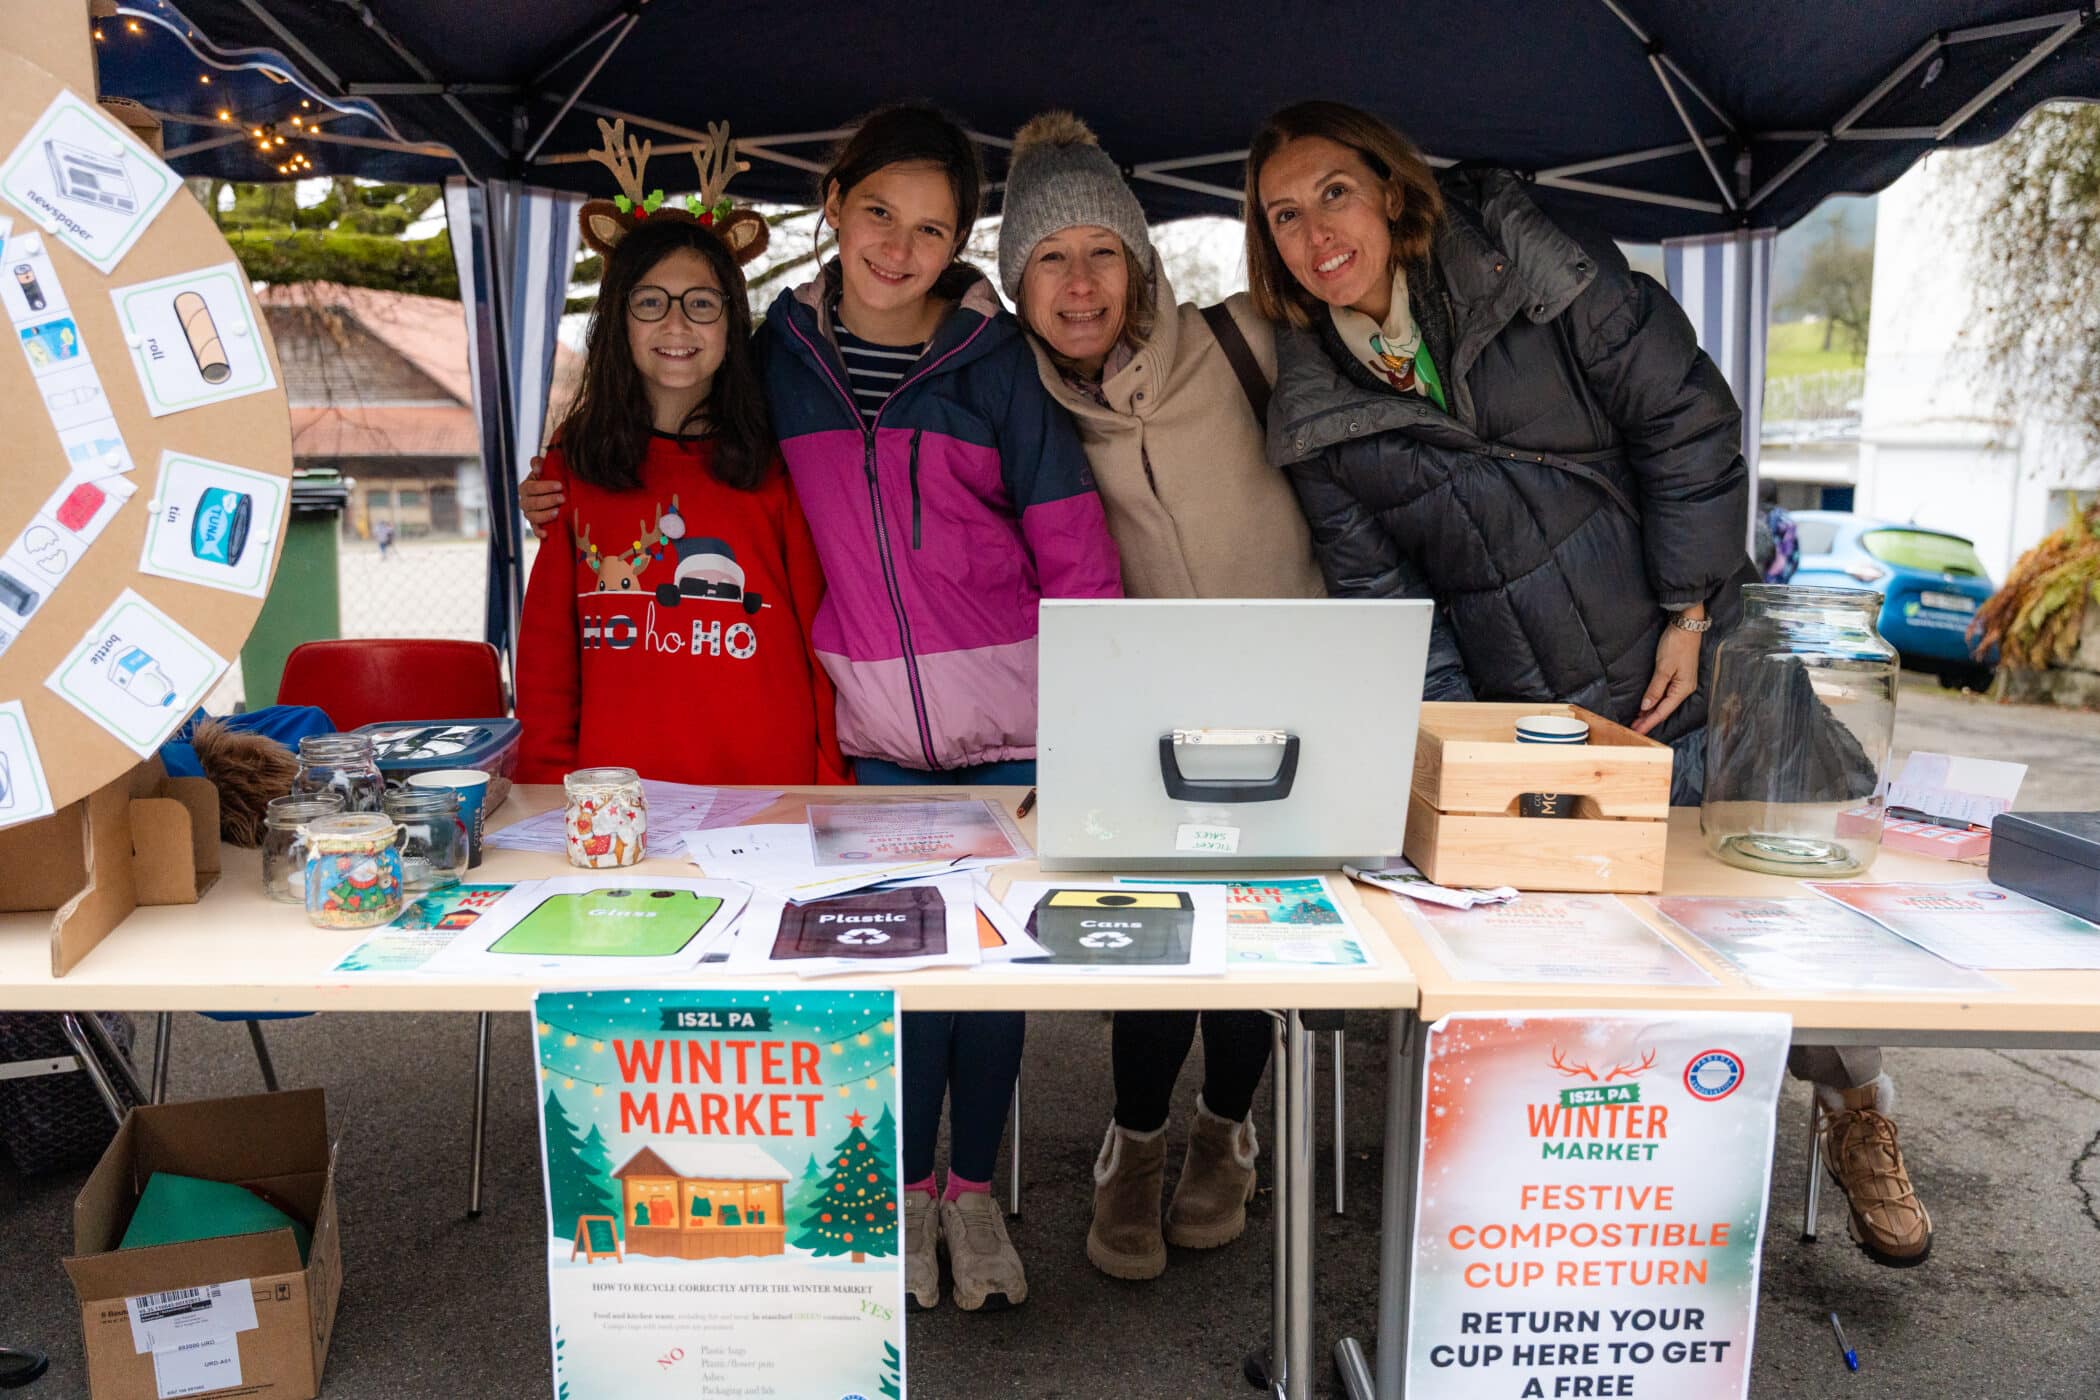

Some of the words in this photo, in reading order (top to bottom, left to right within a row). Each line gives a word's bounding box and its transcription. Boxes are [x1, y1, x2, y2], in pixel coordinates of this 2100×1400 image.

[26, 188, 94, 241] newspaper
[148, 338, 164, 360] roll
[167, 506, 181, 523] tin
[204, 509, 222, 543] TUNA
[584, 615, 637, 650] HO
[645, 601, 685, 653] ho
[691, 620, 757, 659] HO
[90, 634, 122, 665] bottle
[819, 912, 906, 924] Plastic
[1080, 920, 1142, 929] Cans
[678, 1012, 721, 1027] ISZL
[729, 1012, 755, 1028] PA
[613, 1039, 823, 1086] WINTER
[1570, 1089, 1604, 1104] ISZL
[1608, 1087, 1631, 1102] PA
[619, 1091, 824, 1137] MARKET
[1527, 1104, 1669, 1140] WINTER
[1542, 1142, 1659, 1161] MARKET
[1520, 1185, 1674, 1211] FESTIVE
[1448, 1222, 1731, 1249] COMPOSTIBLE
[1464, 1262, 1544, 1288] CUP
[1557, 1259, 1708, 1287] RETURN
[592, 1283, 615, 1292] HOW
[619, 1283, 631, 1292] TO
[634, 1283, 675, 1293] RECYCLE
[678, 1283, 736, 1293] CORRECTLY
[738, 1284, 769, 1293] AFTER
[771, 1285, 791, 1293] THE
[793, 1285, 831, 1293] WINTER
[833, 1285, 873, 1294] MARKET
[860, 1299, 893, 1321] YES
[1461, 1310, 1599, 1335] RETURN
[1609, 1308, 1705, 1333] YOUR
[656, 1347, 685, 1370] NO
[1430, 1345, 1503, 1368] CUP
[1512, 1343, 1599, 1366] HERE
[1608, 1342, 1655, 1364] TO
[1662, 1341, 1731, 1363] GET
[1521, 1377, 1544, 1400] A
[1554, 1375, 1634, 1398] FREE
